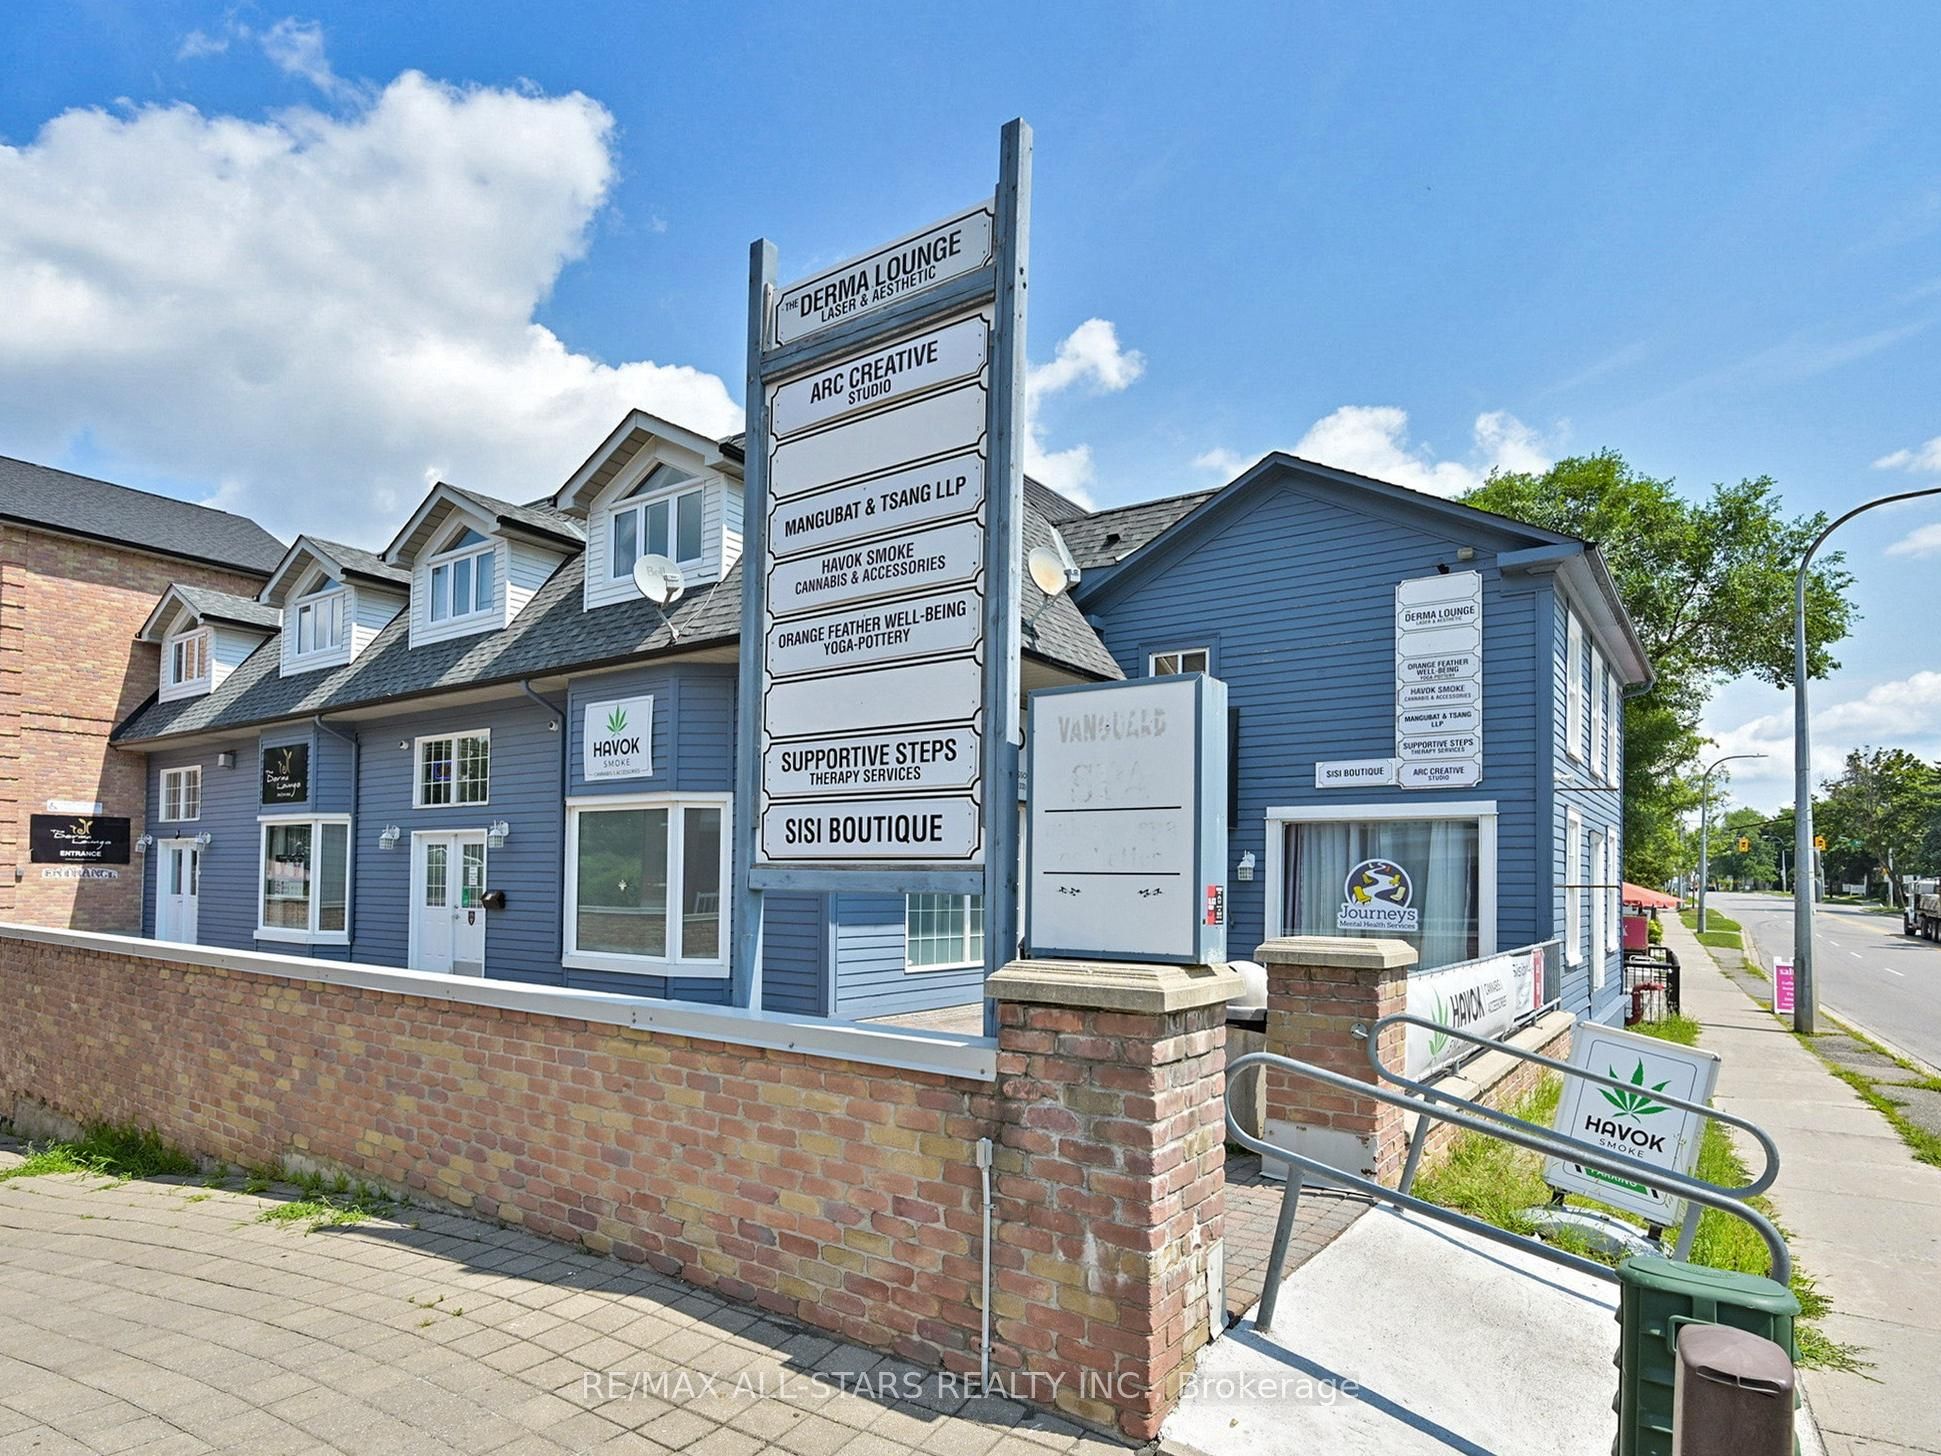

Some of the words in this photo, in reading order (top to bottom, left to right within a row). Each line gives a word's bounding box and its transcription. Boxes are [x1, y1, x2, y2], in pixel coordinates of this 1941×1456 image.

[785, 298, 799, 312] THE
[800, 270, 870, 318] DERMA
[876, 229, 962, 286] LOUNGE
[821, 297, 857, 322] LASER
[860, 292, 869, 306] &
[872, 264, 936, 303] AESTHETIC
[810, 372, 844, 404] ARC
[849, 340, 939, 388] CREATIVE
[848, 378, 892, 405] STUDIO
[784, 500, 861, 538] MANGUBAT
[865, 498, 876, 516] &
[880, 484, 931, 513] TSANG
[936, 475, 967, 500] LLP
[821, 551, 863, 574] HAVOK
[866, 542, 915, 566] SMOKE
[795, 573, 848, 595] CANNABIS
[851, 571, 859, 584] &
[862, 555, 946, 583] ACCESSORIES
[778, 626, 825, 649] ORANGE
[828, 616, 881, 640] FEATHER
[884, 600, 967, 631] WELL-BEING
[1405, 610, 1436, 622] DERMA
[1439, 605, 1475, 618] LOUNGE
[823, 628, 910, 656] YOGA-POTTERY
[1408, 661, 1436, 670] ORANGE
[1438, 658, 1469, 667] FEATHER
[1410, 686, 1436, 695] HAVOK
[1437, 685, 1465, 693] SMOKE
[1404, 713, 1440, 722] MANGUBAT
[1449, 711, 1472, 719] TSANG
[593, 737, 640, 757] HAVOK
[781, 743, 890, 773] SUPPORTIVE
[896, 738, 957, 765] STEPS
[1403, 740, 1448, 750] SUPPORTIVE
[1450, 738, 1474, 746] STEPS
[603, 758, 630, 768] SMOKE
[1326, 768, 1342, 778] SISI
[1343, 766, 1384, 777] BOUTIQUE
[1413, 767, 1428, 776] ARC
[1430, 766, 1464, 775] CREATIVE
[810, 770, 860, 786] THERAPY
[863, 766, 921, 783] SERVICES
[785, 817, 822, 844] SISI
[829, 814, 943, 844] BOUTIQUE
[1340, 905, 1416, 923] Journeys
[1340, 920, 1362, 928] Mental
[1387, 922, 1415, 930] Services
[1450, 986, 1485, 1029] HAVOK
[1584, 1115, 1666, 1153] HAVOK
[1599, 1137, 1645, 1159] SMOKE
